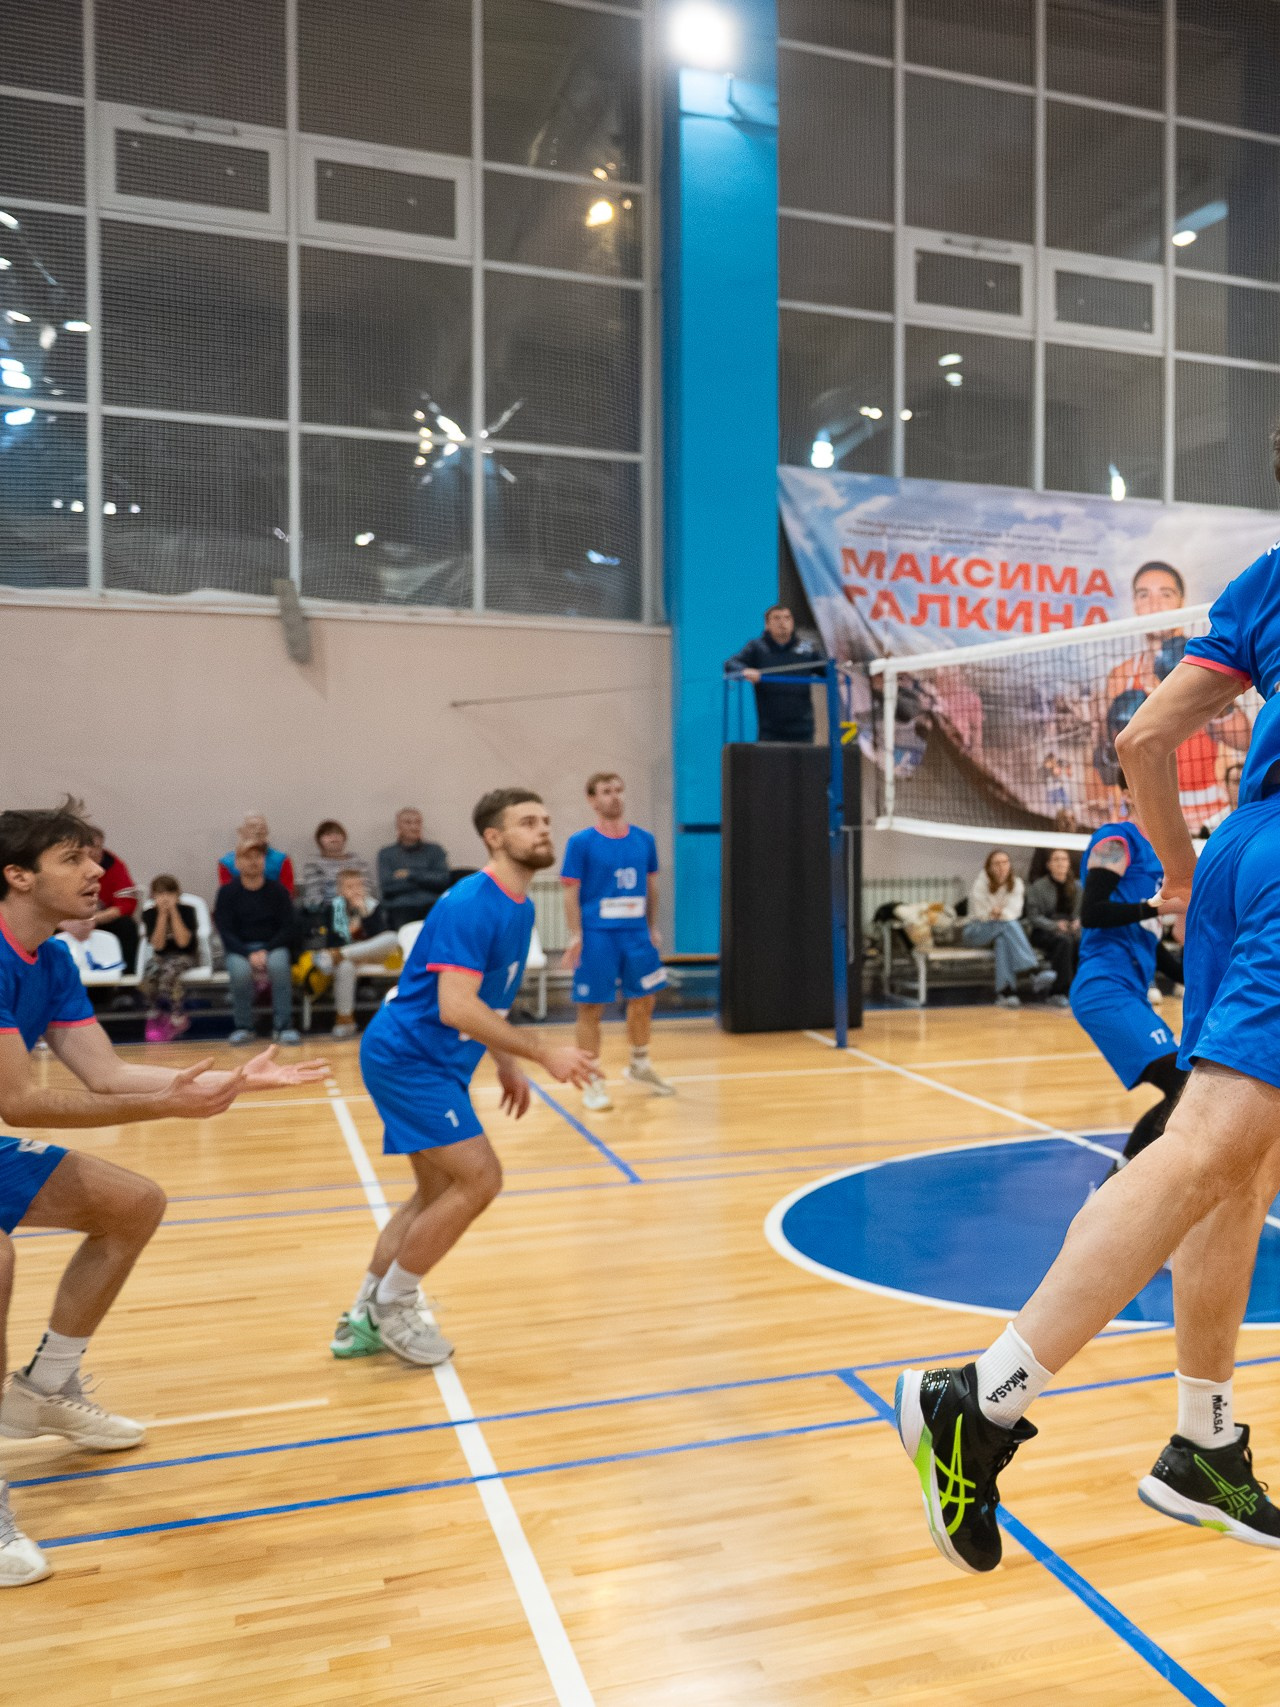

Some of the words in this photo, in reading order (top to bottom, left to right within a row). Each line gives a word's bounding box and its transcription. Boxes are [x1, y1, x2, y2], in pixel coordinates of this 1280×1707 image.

[841, 547, 1115, 598] МАКСИМА
[614, 867, 638, 890] 10
[1149, 1028, 1168, 1045] 17
[444, 1109, 459, 1128] 1
[986, 1366, 1029, 1404] MIKASA
[1212, 1394, 1225, 1435] MIKASA
